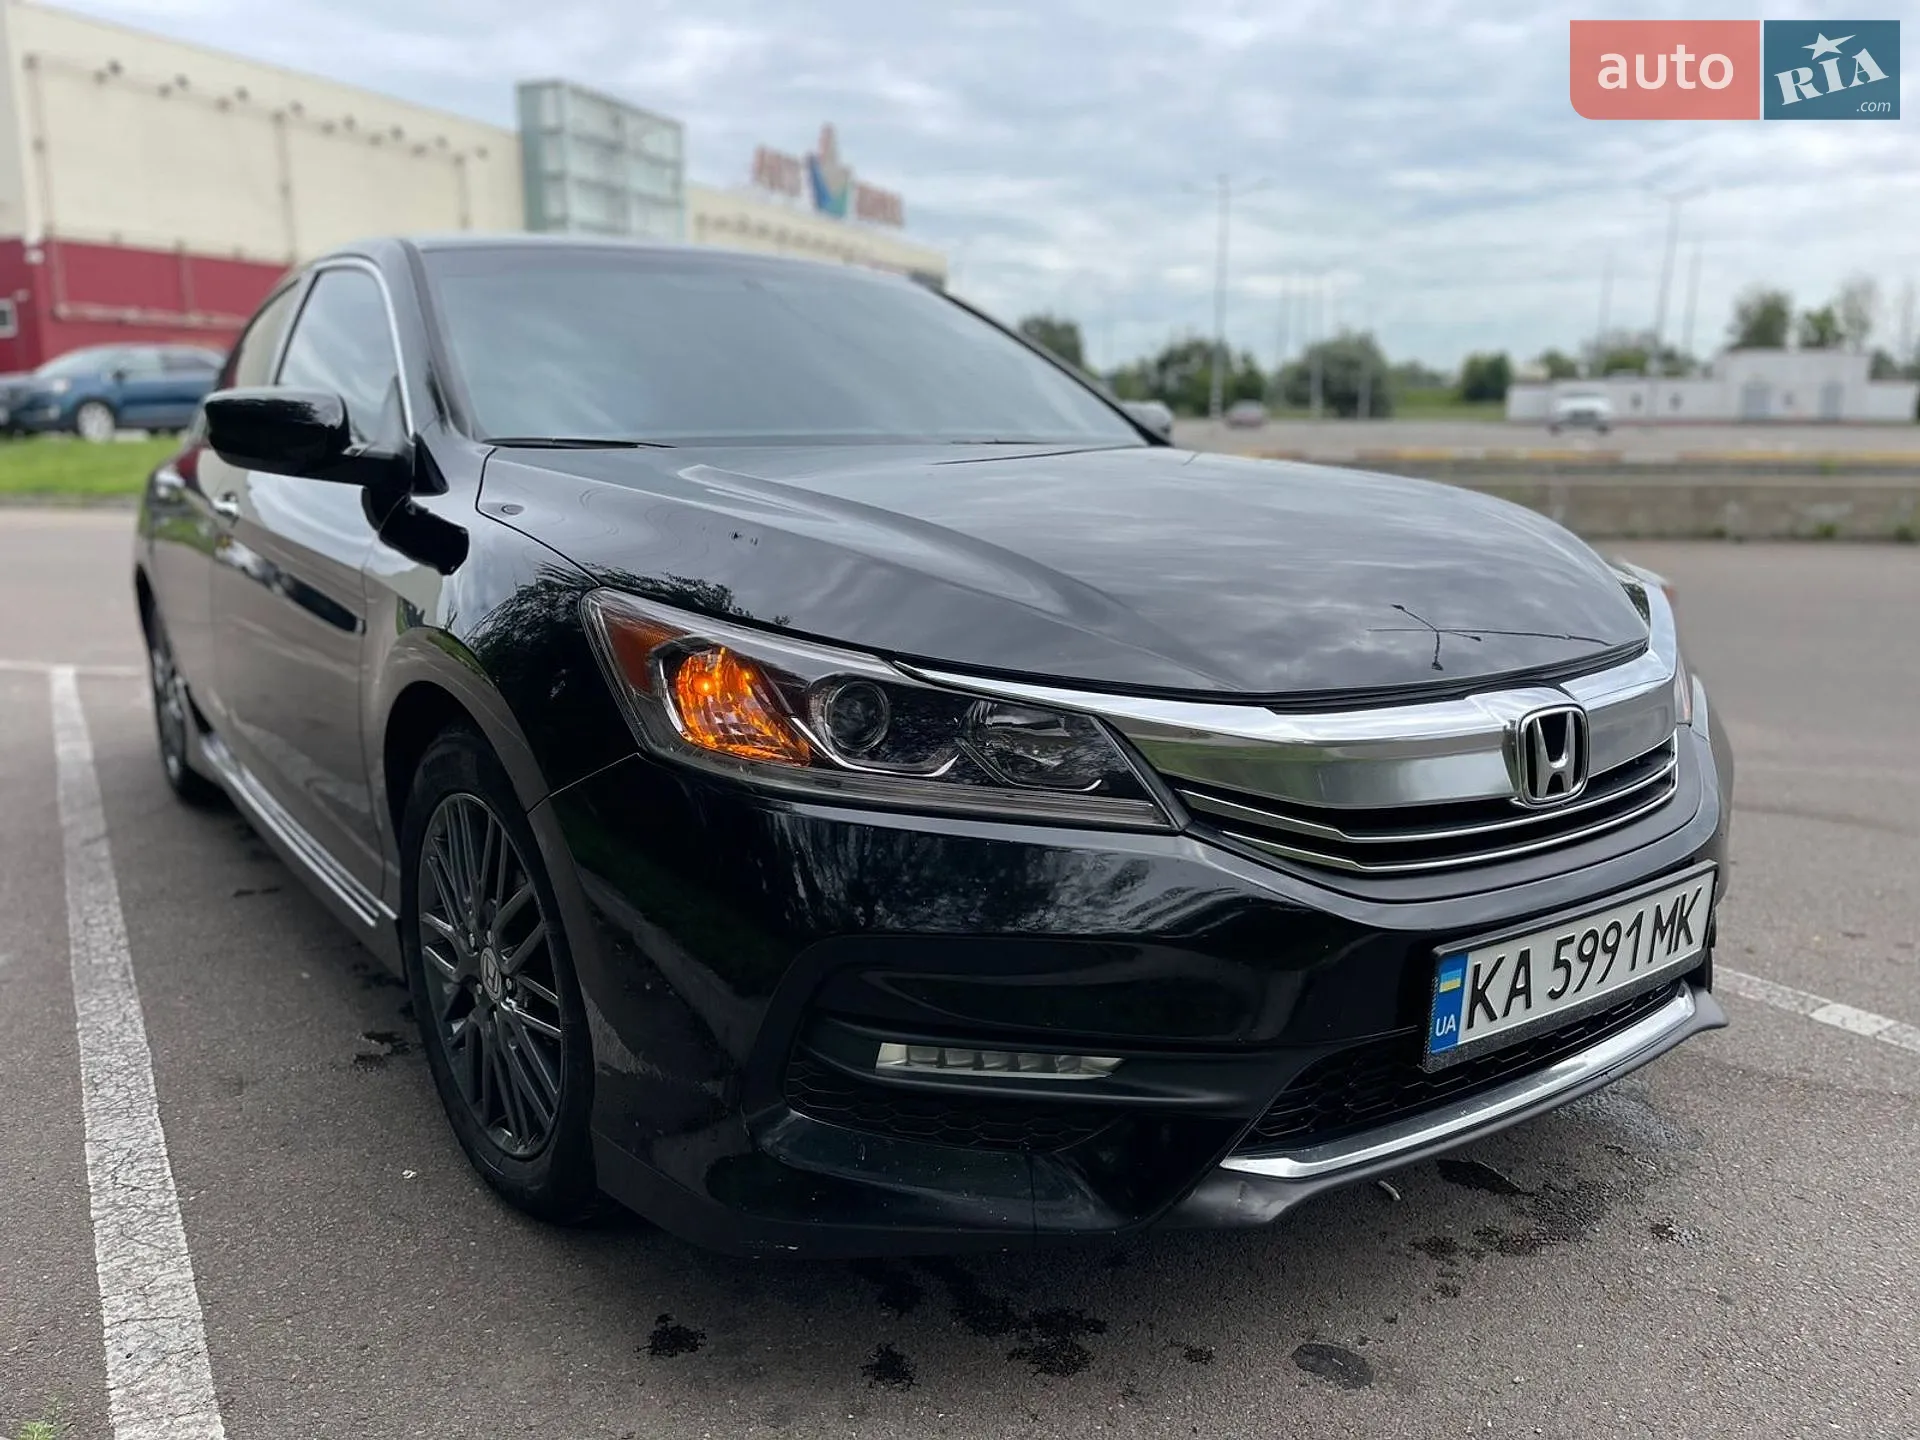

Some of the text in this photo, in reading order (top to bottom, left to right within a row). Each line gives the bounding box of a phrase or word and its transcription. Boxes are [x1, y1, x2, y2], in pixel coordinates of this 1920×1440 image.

[1465, 886, 1703, 1030] KA 5991 MK
[1435, 1015, 1456, 1037] UA
